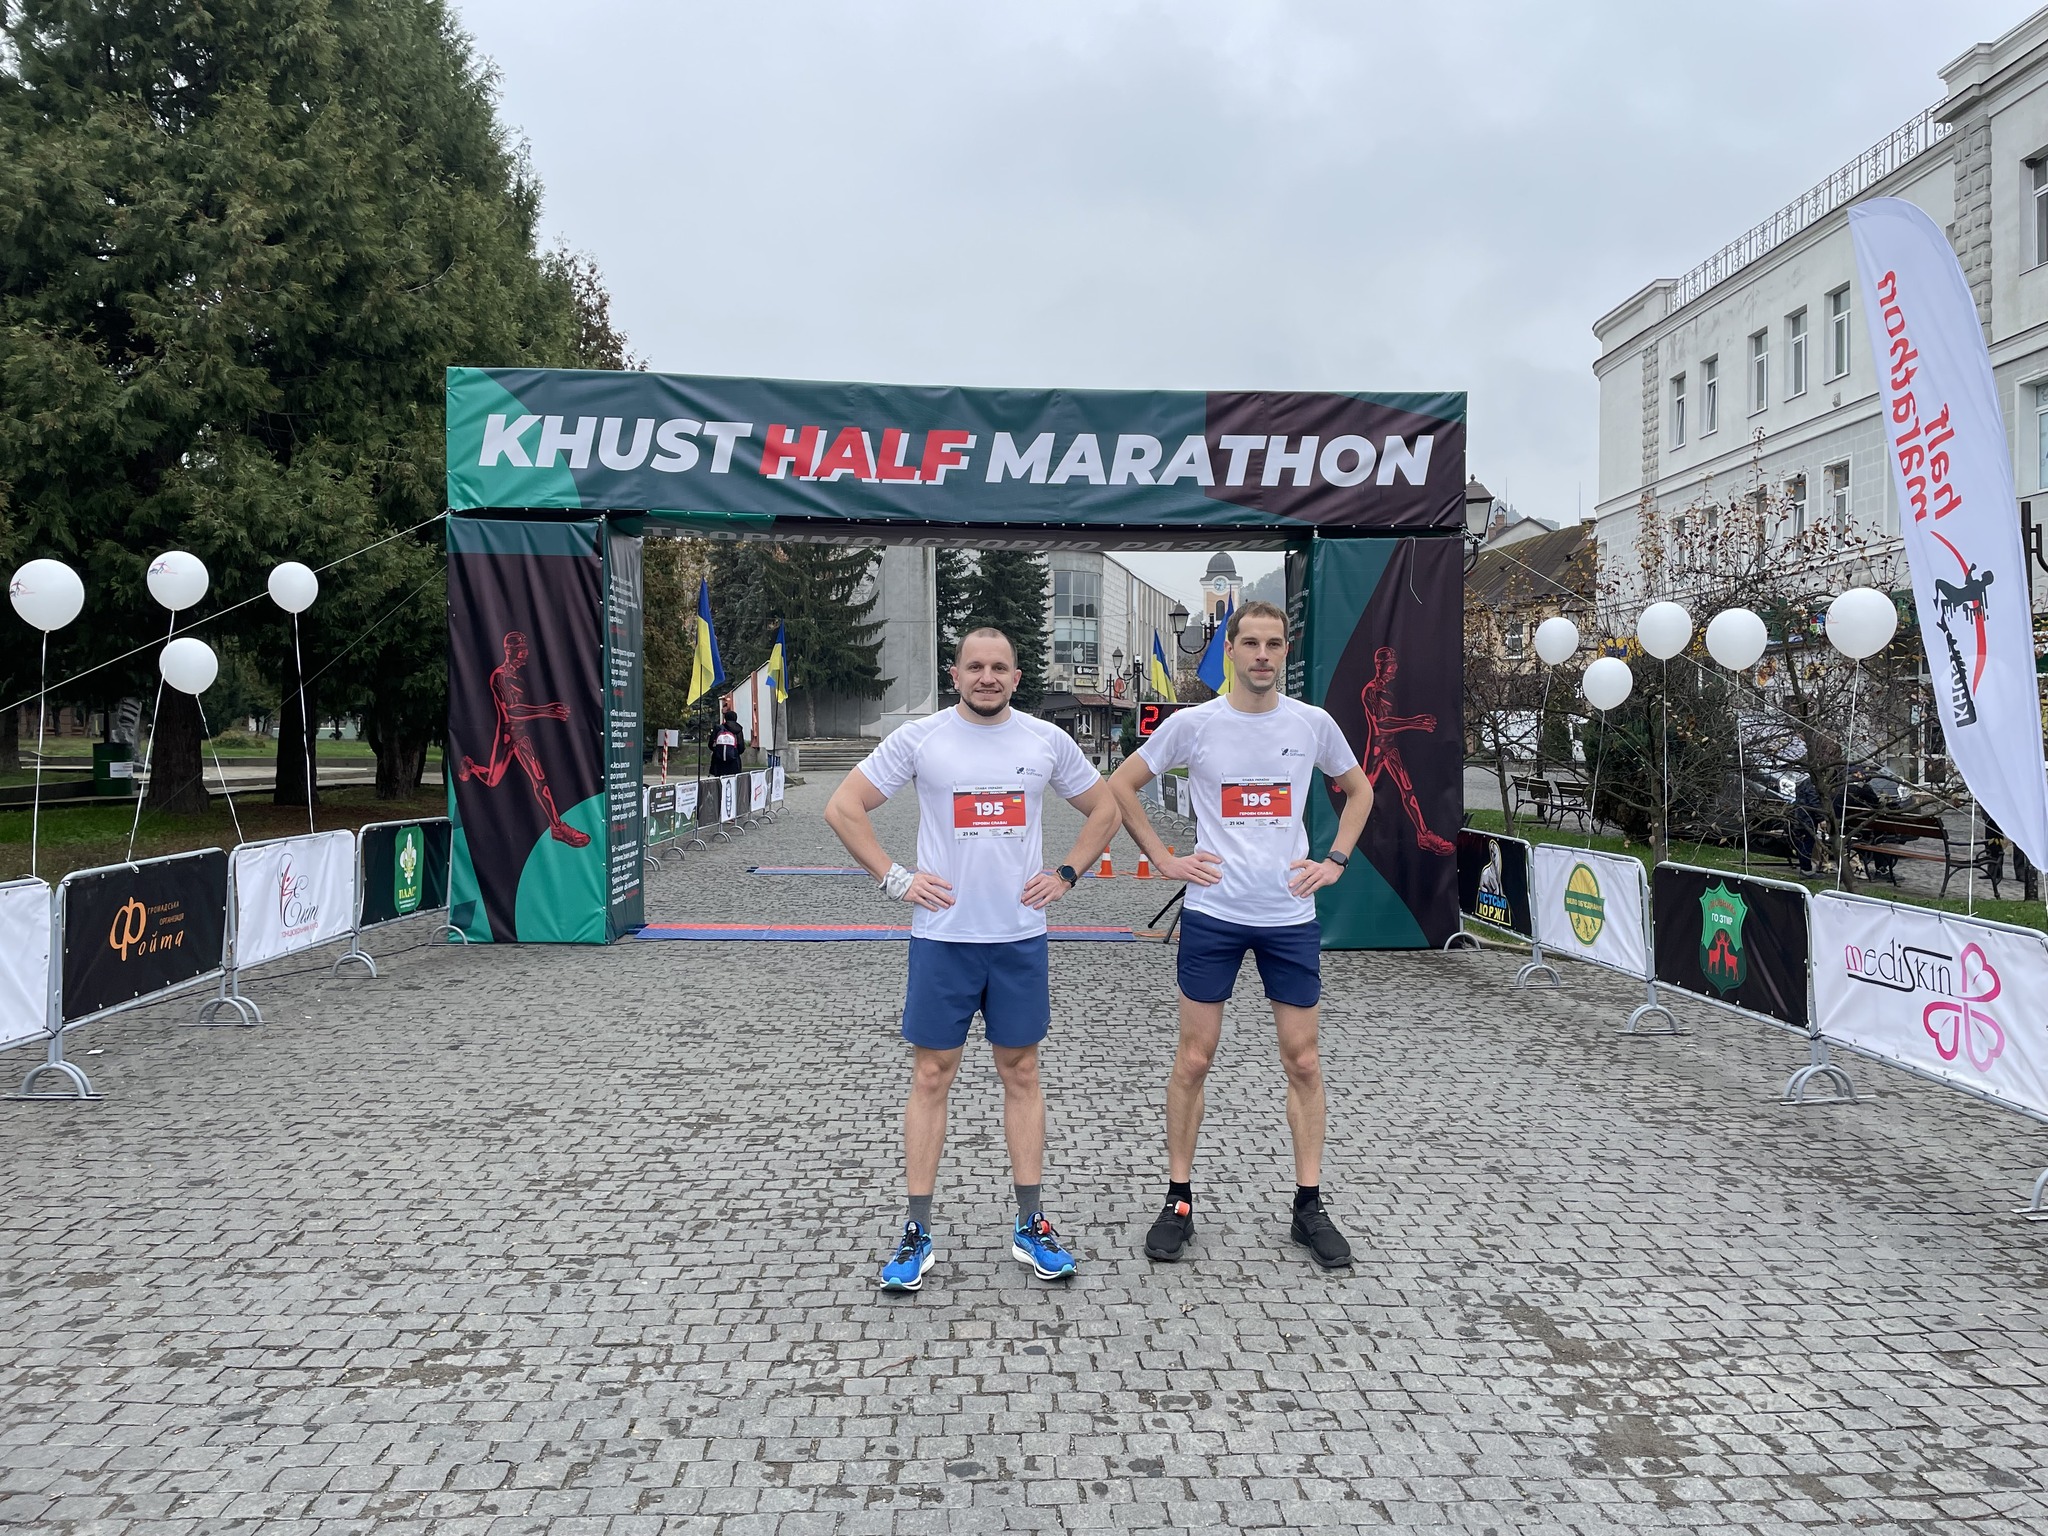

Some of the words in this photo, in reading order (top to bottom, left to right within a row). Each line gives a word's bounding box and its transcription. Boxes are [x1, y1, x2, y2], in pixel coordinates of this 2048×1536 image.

[478, 413, 753, 475] KHUST
[758, 424, 977, 486] HALF
[985, 431, 1434, 487] MARATHON
[1240, 792, 1271, 807] 196
[974, 801, 1005, 816] 195
